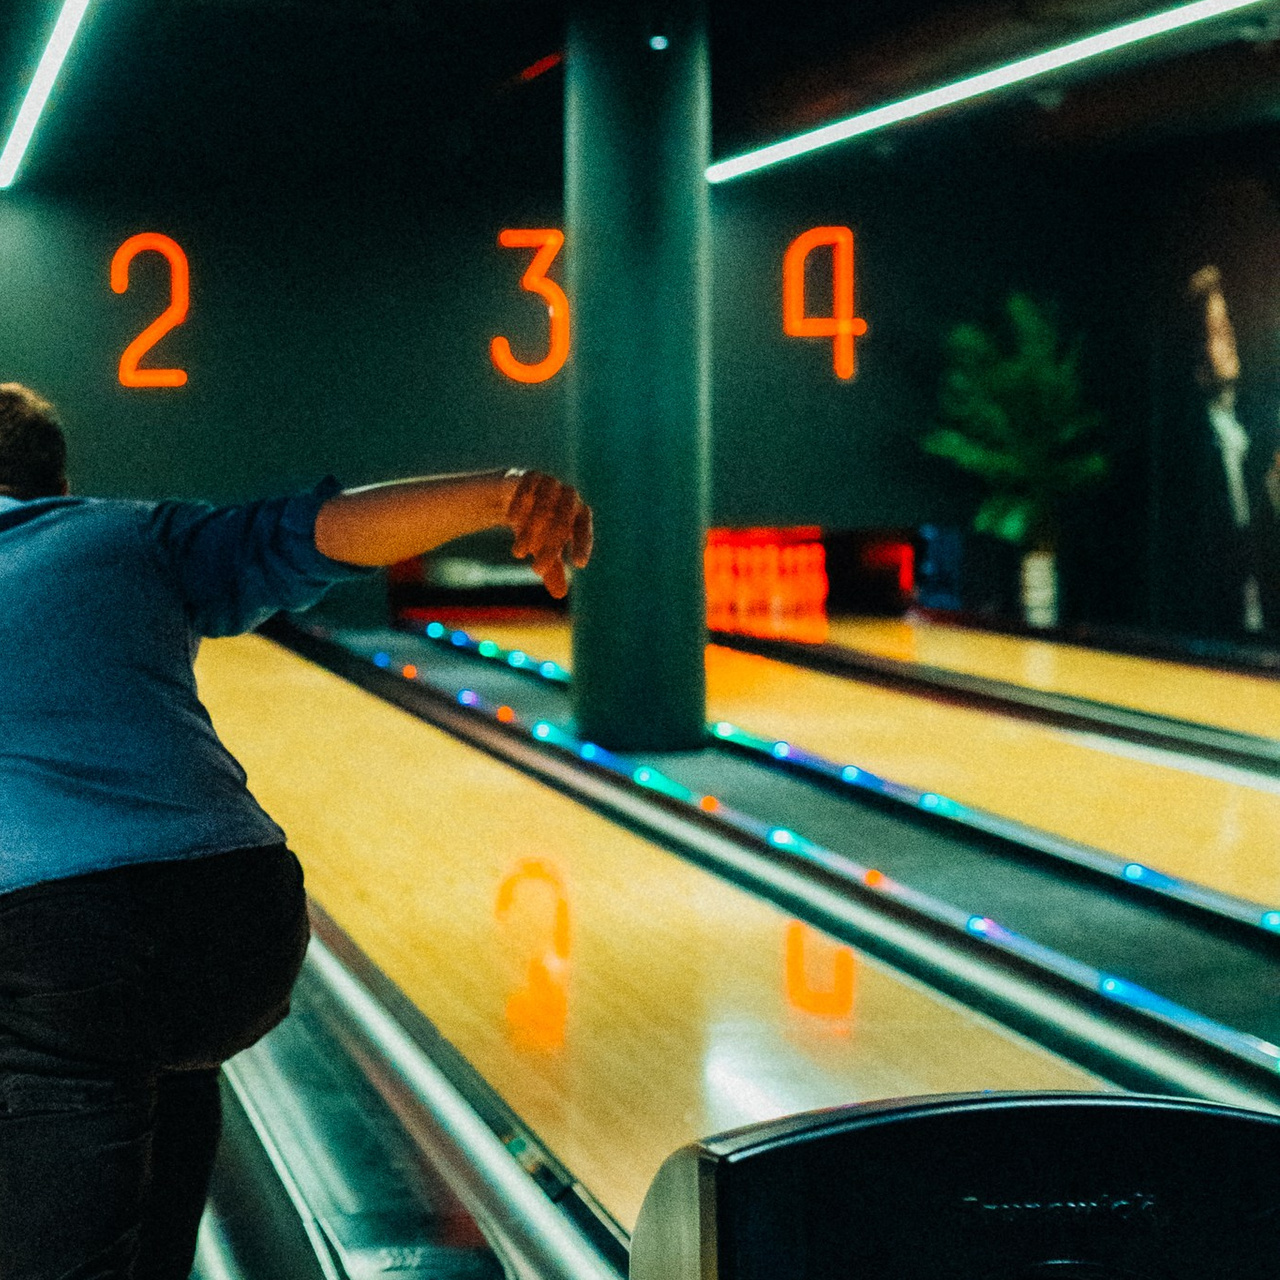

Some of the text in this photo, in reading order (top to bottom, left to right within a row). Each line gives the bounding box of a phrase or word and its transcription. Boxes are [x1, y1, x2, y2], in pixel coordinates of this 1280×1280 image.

[110, 232, 189, 387] 2
[489, 228, 570, 384] 3
[783, 226, 868, 380] 4
